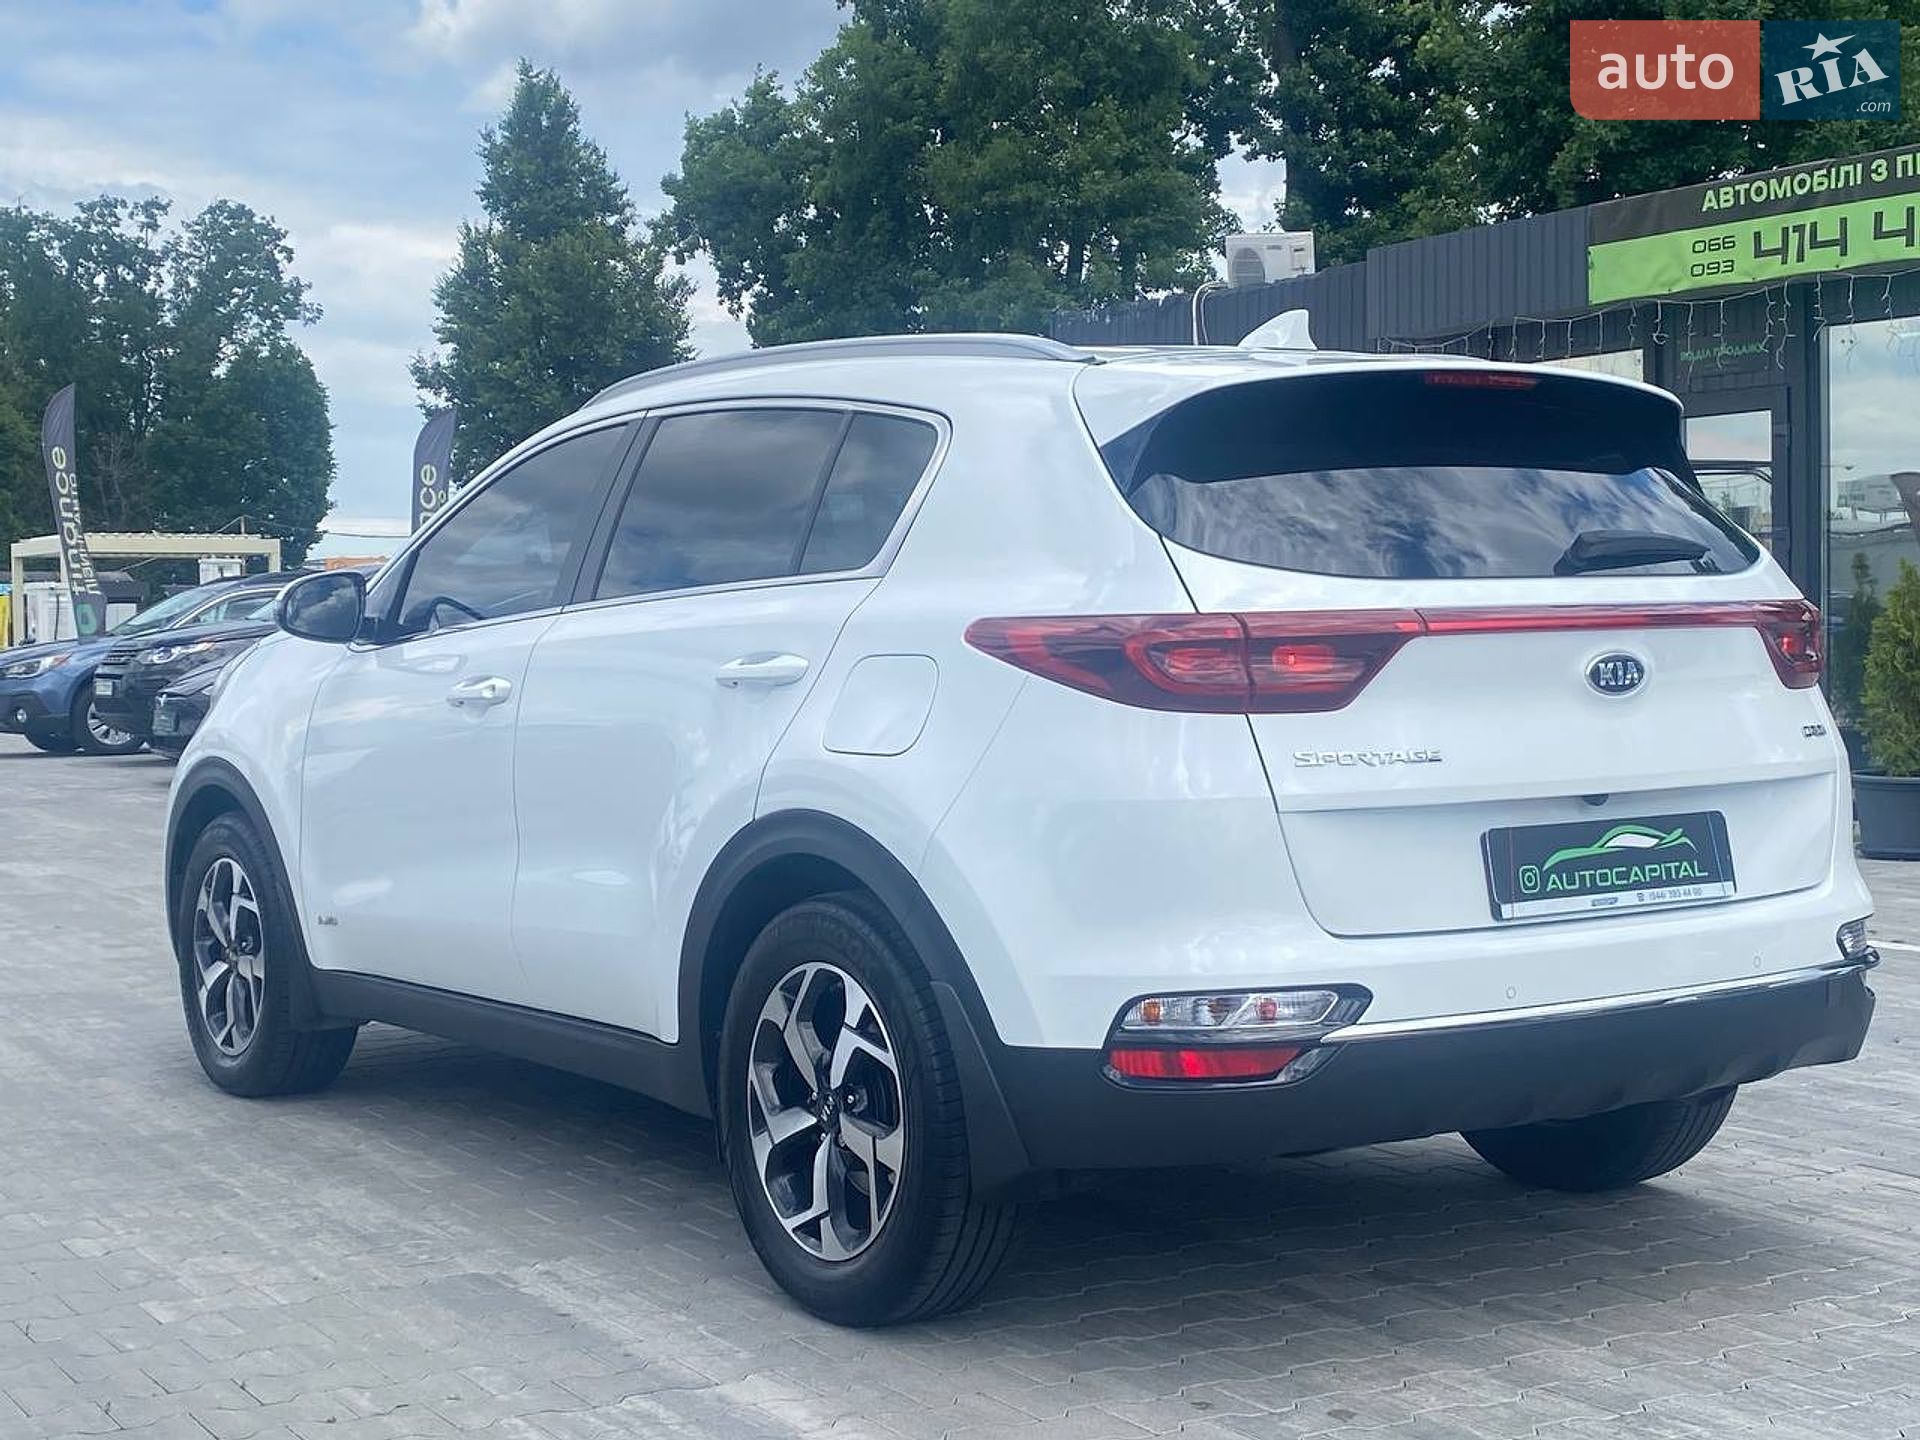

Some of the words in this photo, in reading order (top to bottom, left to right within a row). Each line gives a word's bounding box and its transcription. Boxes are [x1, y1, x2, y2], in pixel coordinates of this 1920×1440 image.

[1702, 163, 1862, 212] АВТОМОБІЛІ
[1692, 235, 1736, 254] 066
[1753, 216, 1847, 265] 414
[1873, 205, 1920, 248] 4
[1690, 259, 1735, 277] 093
[52, 446, 86, 595] finance
[1598, 661, 1639, 686] KIA
[1293, 750, 1442, 767] SPORTAGE
[1547, 861, 1708, 892] AUTOCAPITAL
